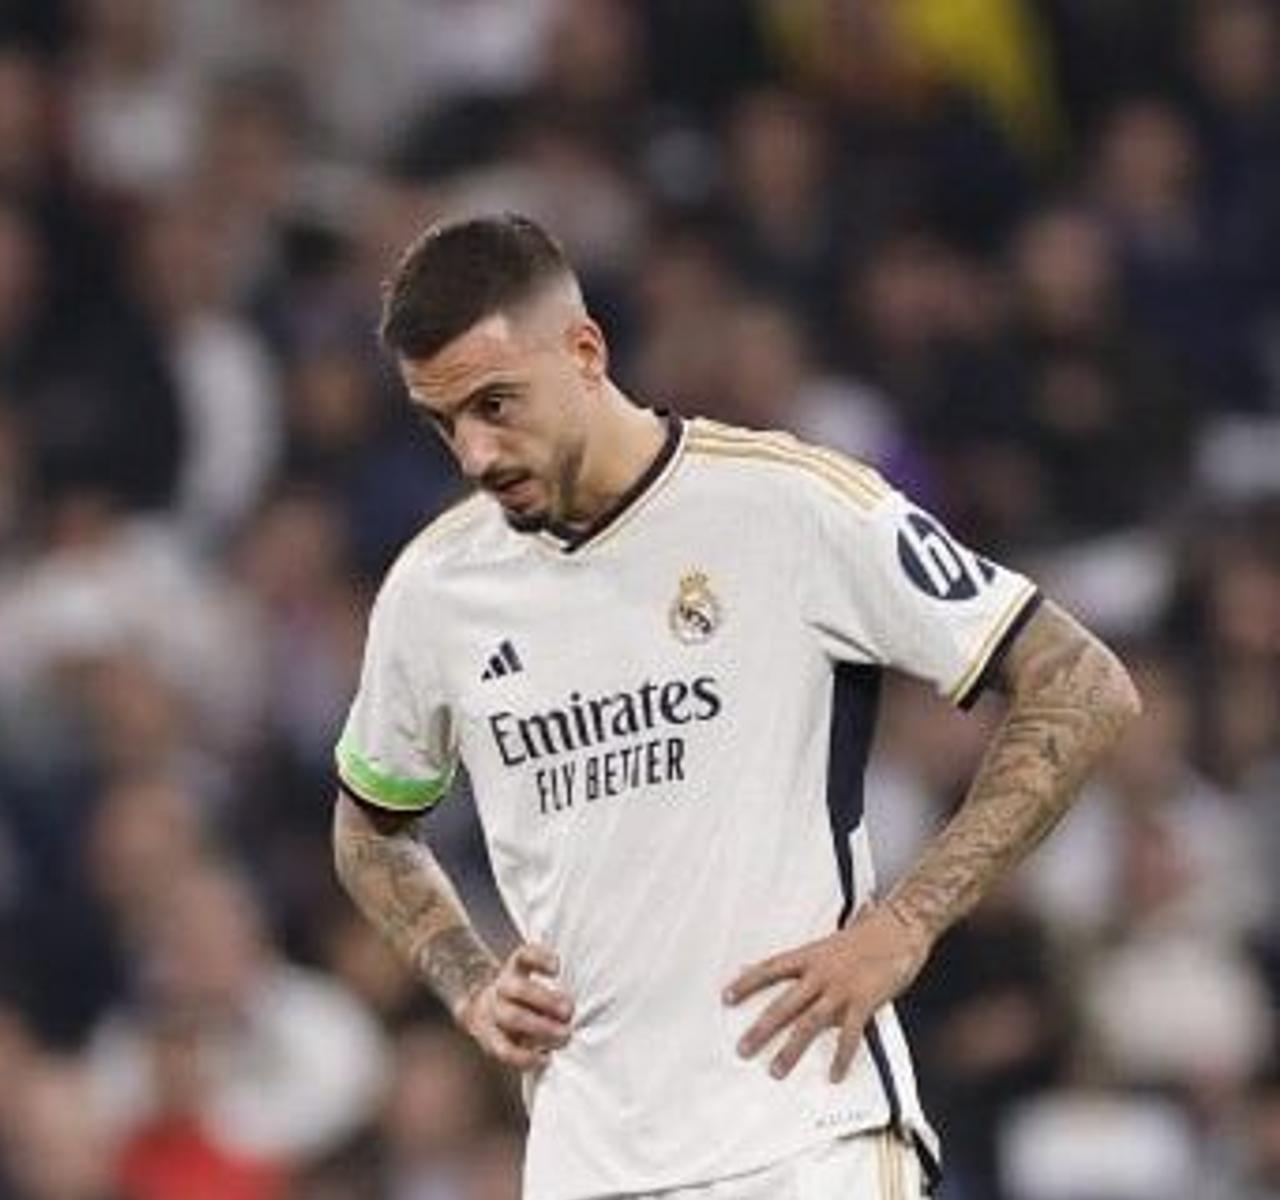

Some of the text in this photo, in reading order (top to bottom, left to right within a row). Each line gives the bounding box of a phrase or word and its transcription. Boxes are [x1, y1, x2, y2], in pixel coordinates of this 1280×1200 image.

[489, 676, 722, 766] Emirates
[536, 737, 685, 814] FLY BETTER
